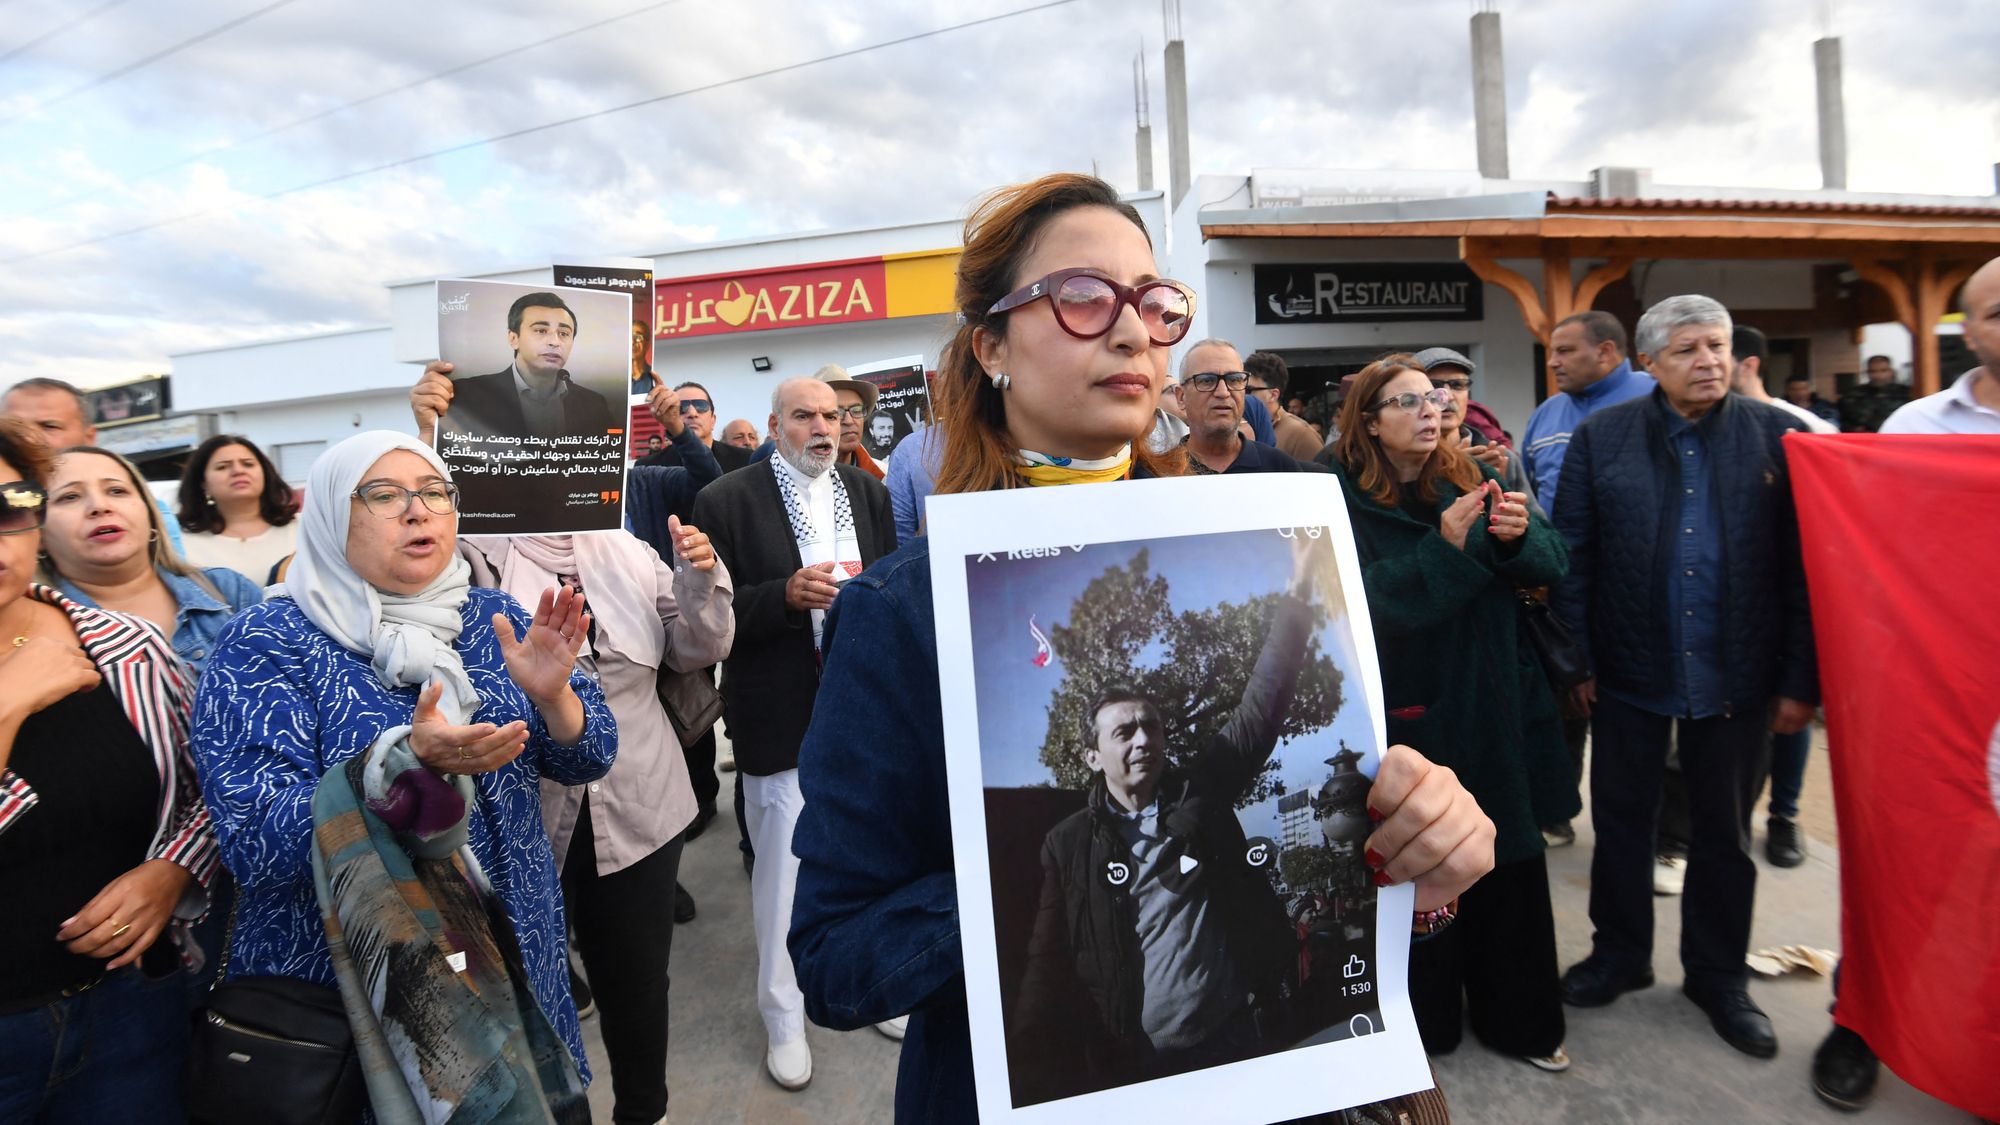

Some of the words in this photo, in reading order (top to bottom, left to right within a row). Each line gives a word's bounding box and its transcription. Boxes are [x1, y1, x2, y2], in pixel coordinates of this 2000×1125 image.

[564, 275, 587, 286] يموت
[587, 276, 607, 285] قاعد
[608, 278, 628, 287] جوهر
[628, 279, 647, 289] ولدي
[750, 278, 873, 324] AZIZA
[655, 291, 717, 335] عزيز
[443, 431, 483, 443] سأجبرك
[523, 435, 548, 447] ببطء
[549, 435, 583, 448] تقتلني
[583, 434, 609, 446] أتركك
[611, 435, 622, 447] لن
[543, 450, 570, 461] وجهك
[572, 449, 600, 459] كشف
[601, 450, 621, 461] على
[462, 462, 489, 475] أموت
[491, 463, 501, 475] أو
[503, 464, 518, 476] حرا
[519, 463, 559, 476] سأعيش
[599, 464, 620, 474] يداك
[1252, 851, 1262, 860] 10
[1112, 868, 1123, 878] 10
[1341, 986, 1347, 997] 1
[1350, 982, 1371, 995] 530
